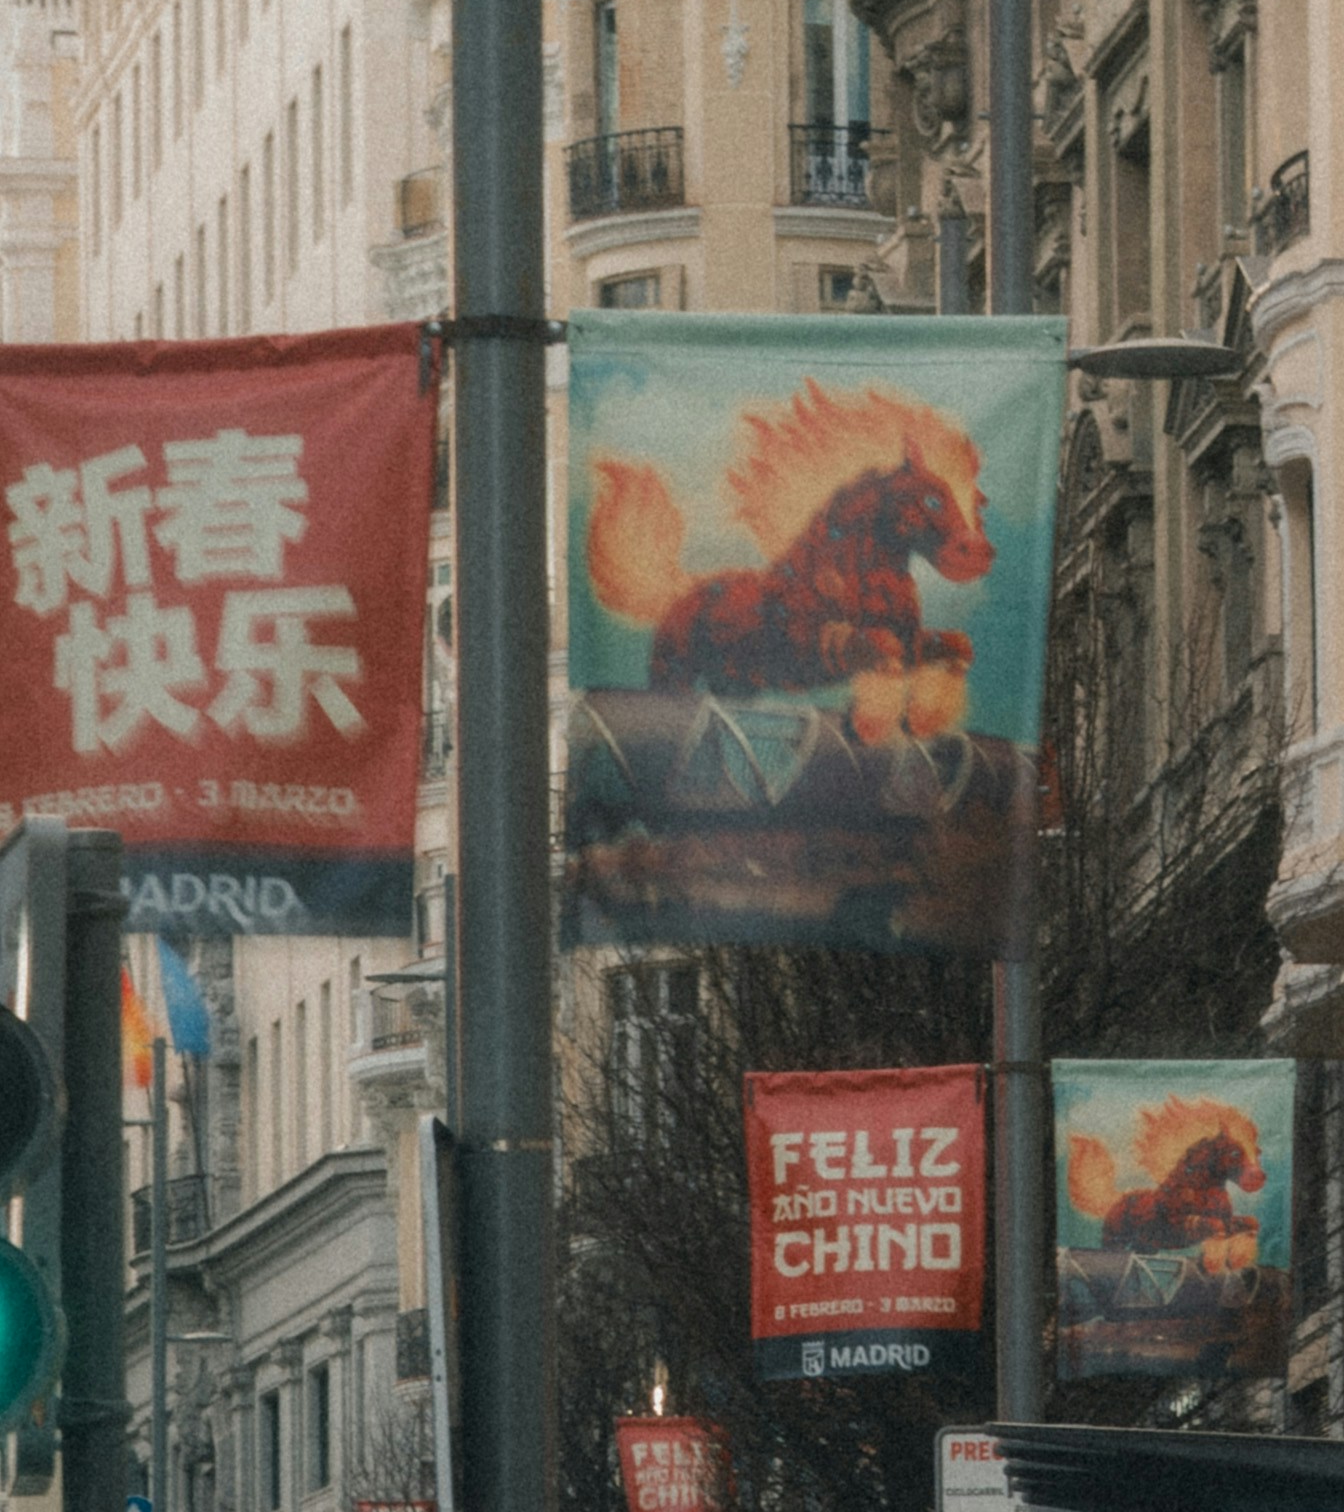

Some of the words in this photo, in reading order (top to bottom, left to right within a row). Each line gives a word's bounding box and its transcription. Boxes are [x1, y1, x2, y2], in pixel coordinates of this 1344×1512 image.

[5, 428, 309, 617] 新春
[53, 585, 366, 754] 快乐
[198, 779, 220, 807] 3
[230, 779, 356, 816] MARZO
[770, 1127, 961, 1185] FELIZ
[772, 1185, 838, 1223] AÑO
[847, 1186, 962, 1215] NUEVO
[774, 1222, 962, 1277] CHINO
[790, 1298, 864, 1319] FEBRERO
[880, 1298, 891, 1312] 3
[896, 1296, 956, 1314] MARZO
[830, 1344, 931, 1371] MADRID
